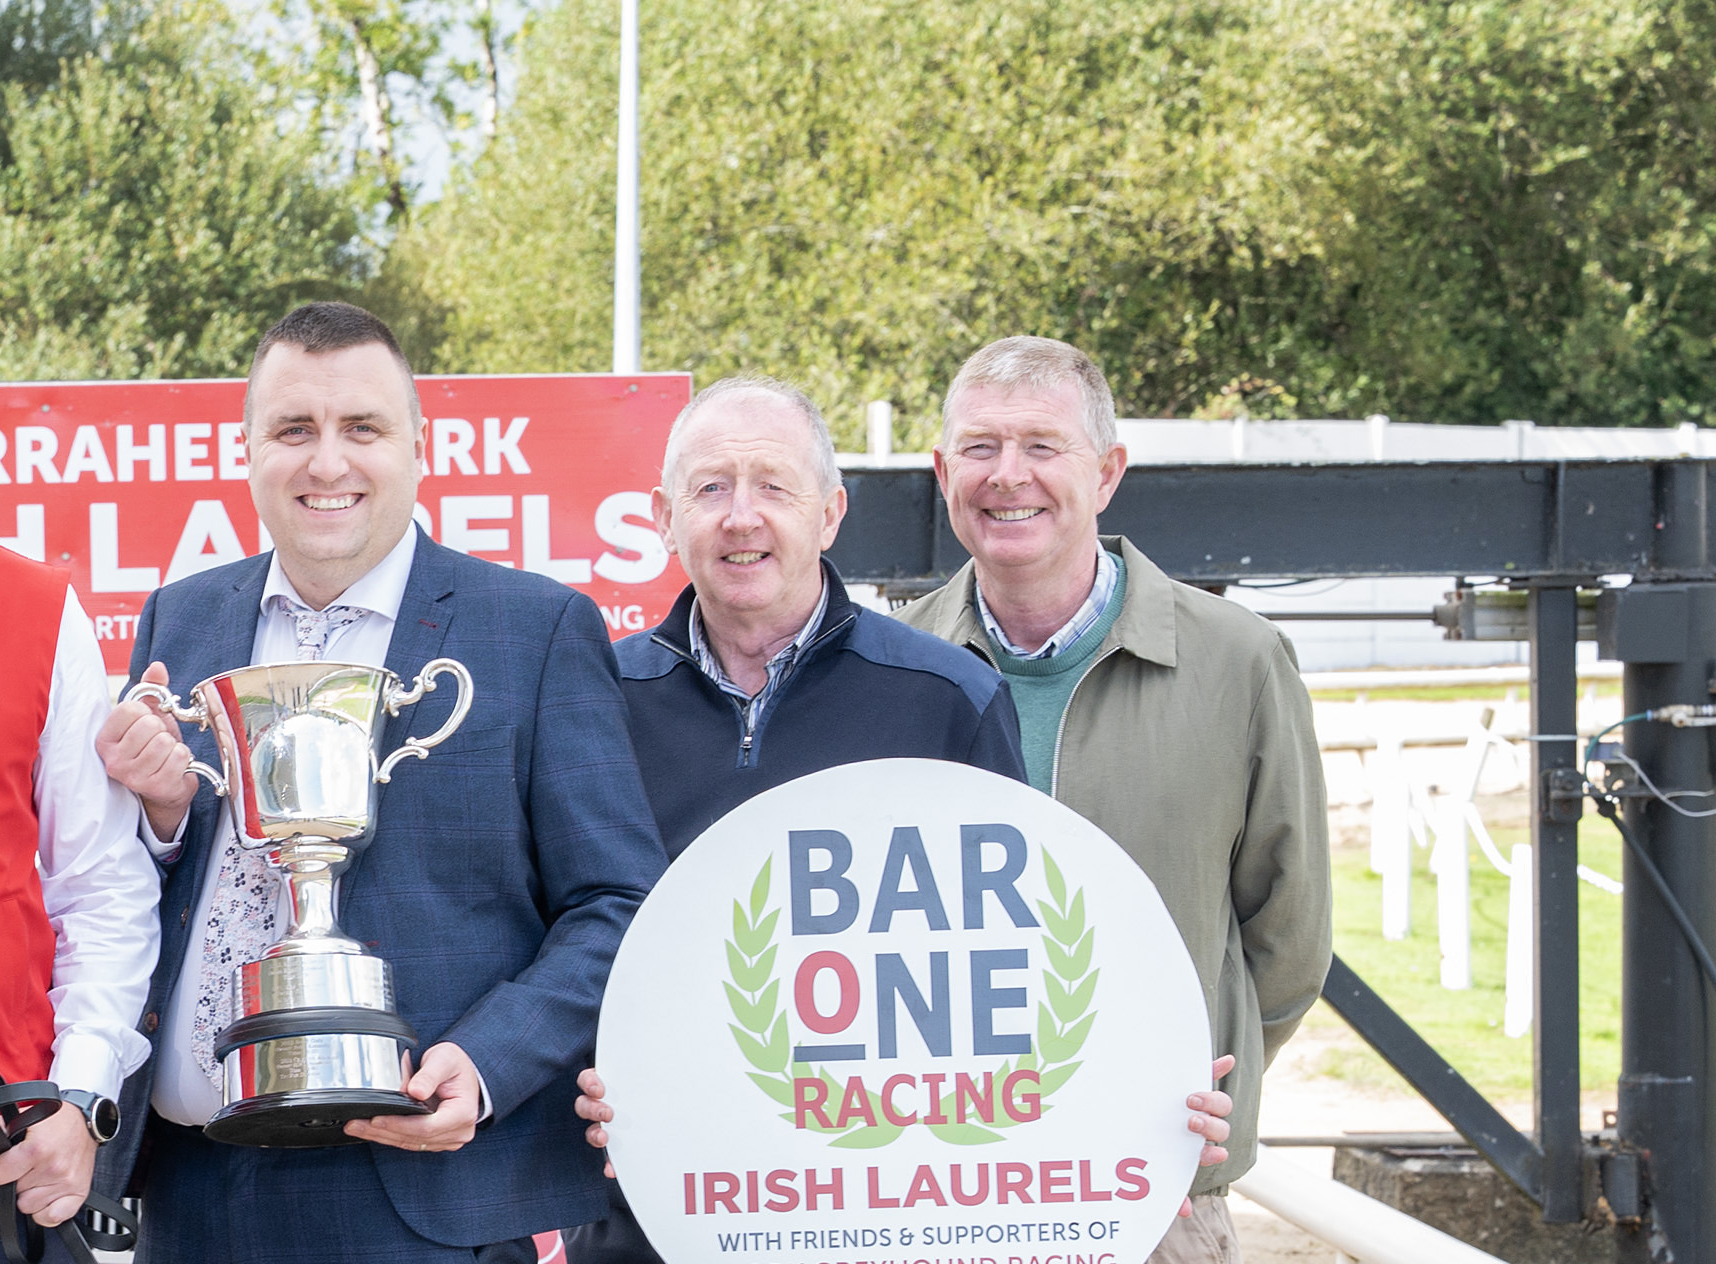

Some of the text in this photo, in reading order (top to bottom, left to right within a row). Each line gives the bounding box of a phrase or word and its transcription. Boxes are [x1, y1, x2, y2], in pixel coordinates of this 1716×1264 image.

[422, 417, 531, 476] RK
[89, 491, 670, 592] LAELS
[787, 823, 1041, 936] BAR
[794, 948, 1032, 1062] ONE
[794, 1070, 1042, 1129] RACING
[684, 1157, 1151, 1215] IRISH LAURELS
[718, 1221, 1120, 1252] WITH FRIENDS & SUPPORTERS OF
